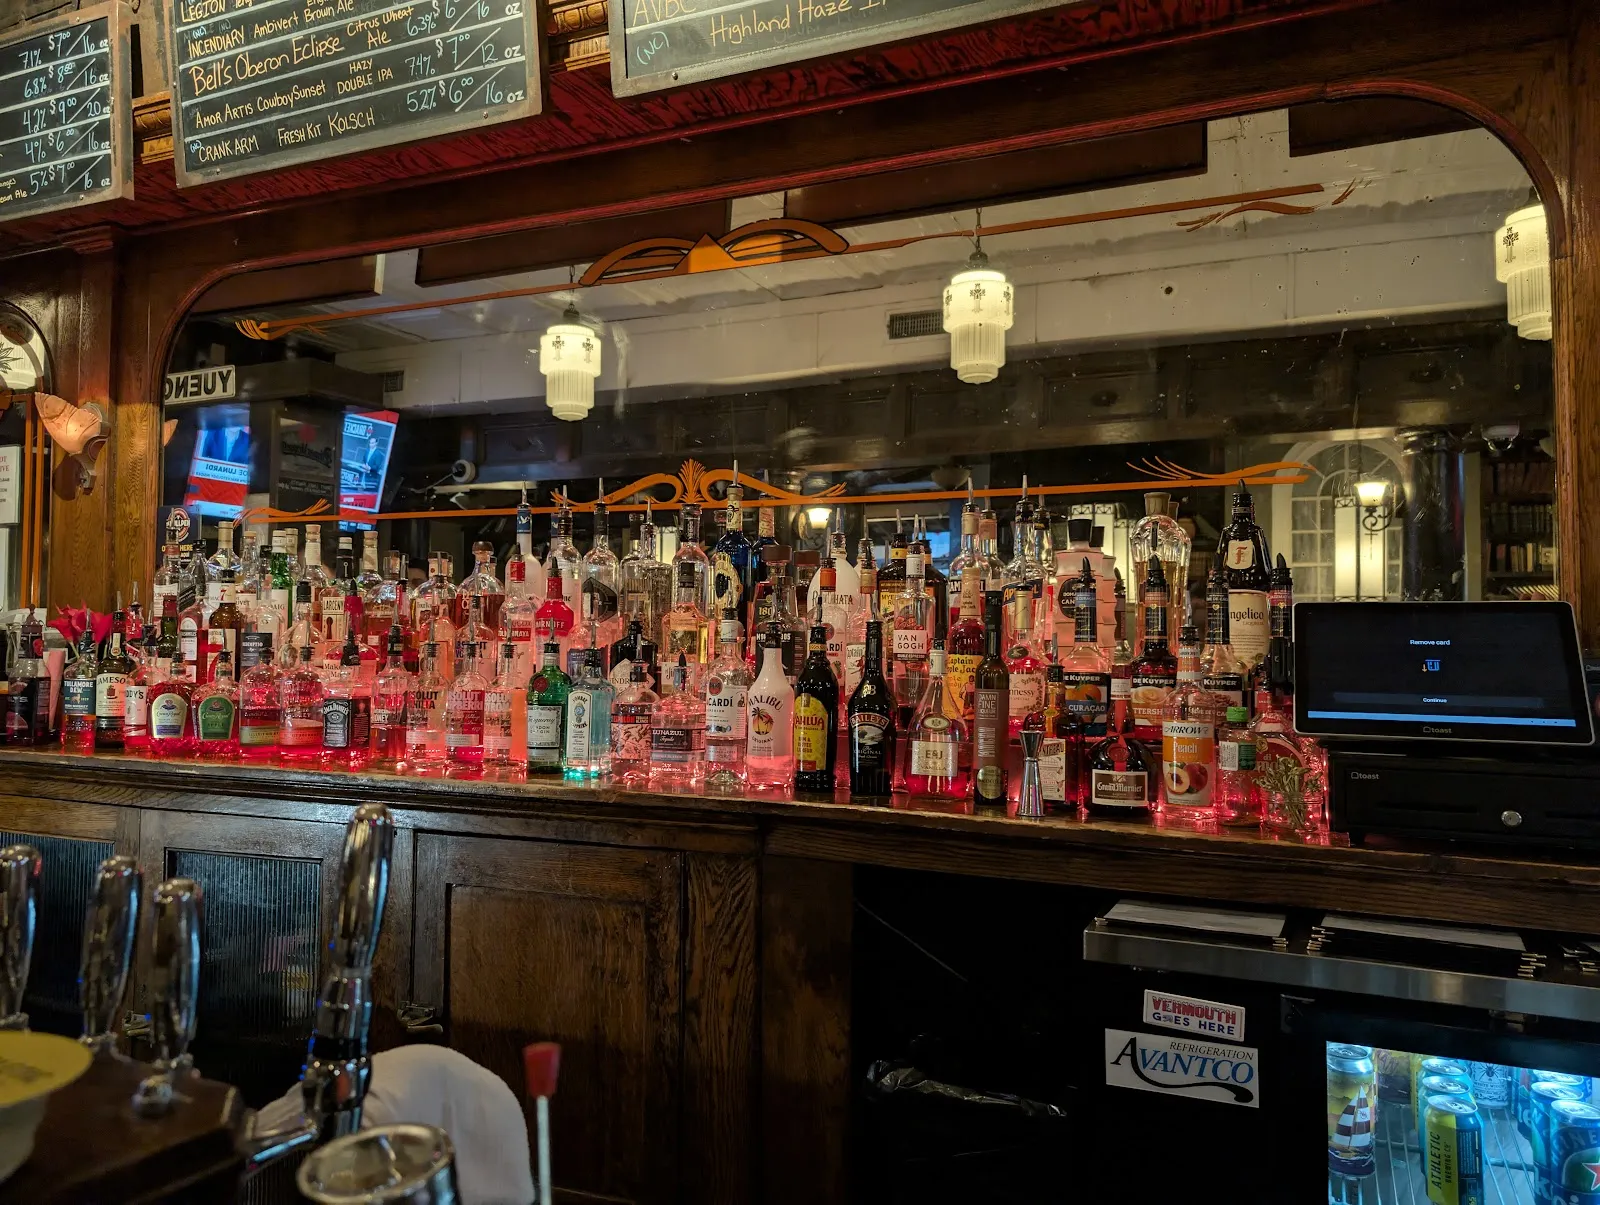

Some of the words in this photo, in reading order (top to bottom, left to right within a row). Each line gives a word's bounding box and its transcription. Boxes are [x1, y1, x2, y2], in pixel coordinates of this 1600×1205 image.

[180, 0, 226, 23] LEGION
[633, 0, 696, 27] AVBC
[187, 25, 245, 61] INCENDIARY
[253, 11, 299, 39] Ambivert
[304, 6, 335, 23] Brown
[336, 0, 355, 14] Ale
[709, 5, 790, 47] Highland
[798, 0, 852, 24] Haze
[83, 35, 95, 54] 16
[367, 29, 392, 50] Ale
[189, 59, 232, 96] Bell's
[235, 51, 290, 80] Oberon
[292, 35, 346, 65] Eclipse
[346, 17, 380, 36] Citrus
[382, 6, 415, 25] Wheat
[481, 43, 498, 65] 12
[349, 58, 373, 74] HAZY
[24, 76, 47, 98] 6.8%
[84, 69, 97, 86] 16
[486, 81, 503, 104] 16
[195, 109, 223, 130] AMOR
[224, 102, 254, 123] ARTIS
[337, 73, 373, 95] DOUBLE
[378, 67, 394, 83] IPA
[23, 108, 46, 134] 4.2%
[86, 101, 101, 117] 20
[198, 138, 233, 163] CRANK
[234, 134, 260, 156] ARM
[277, 126, 306, 147] FRESH
[306, 121, 322, 139] KIT
[328, 107, 376, 137] KOLSCH
[25, 138, 46, 163] 4%
[88, 131, 99, 151] 16
[30, 170, 48, 195] 5%
[15, 189, 28, 199] Ale
[323, 600, 343, 611] LARCEN
[1230, 607, 1264, 621] ngelico
[64, 680, 94, 688] TULLAMORE
[97, 676, 126, 685] JAMESO
[1069, 674, 1100, 682] KUYPER
[708, 696, 733, 707] CARDÍ
[1009, 688, 1035, 697] nnessy
[749, 694, 784, 712] MALIBU
[978, 700, 996, 709] FINE
[851, 713, 886, 726] BAILEYS
[1431, 726, 1452, 734] toast
[925, 749, 943, 759] E&J
[1174, 743, 1198, 753] Peach
[1096, 780, 1117, 792] Grand
[1116, 782, 1143, 793] Marnier
[1152, 996, 1236, 1025] VERMOUTH
[1198, 1020, 1235, 1036] HERE
[1169, 1041, 1254, 1060] REFRIGERATION
[1110, 1036, 1254, 1085] AVANTCO
[1430, 1131, 1442, 1189] ATHLETIC
[1444, 1153, 1453, 1184] BREWING
